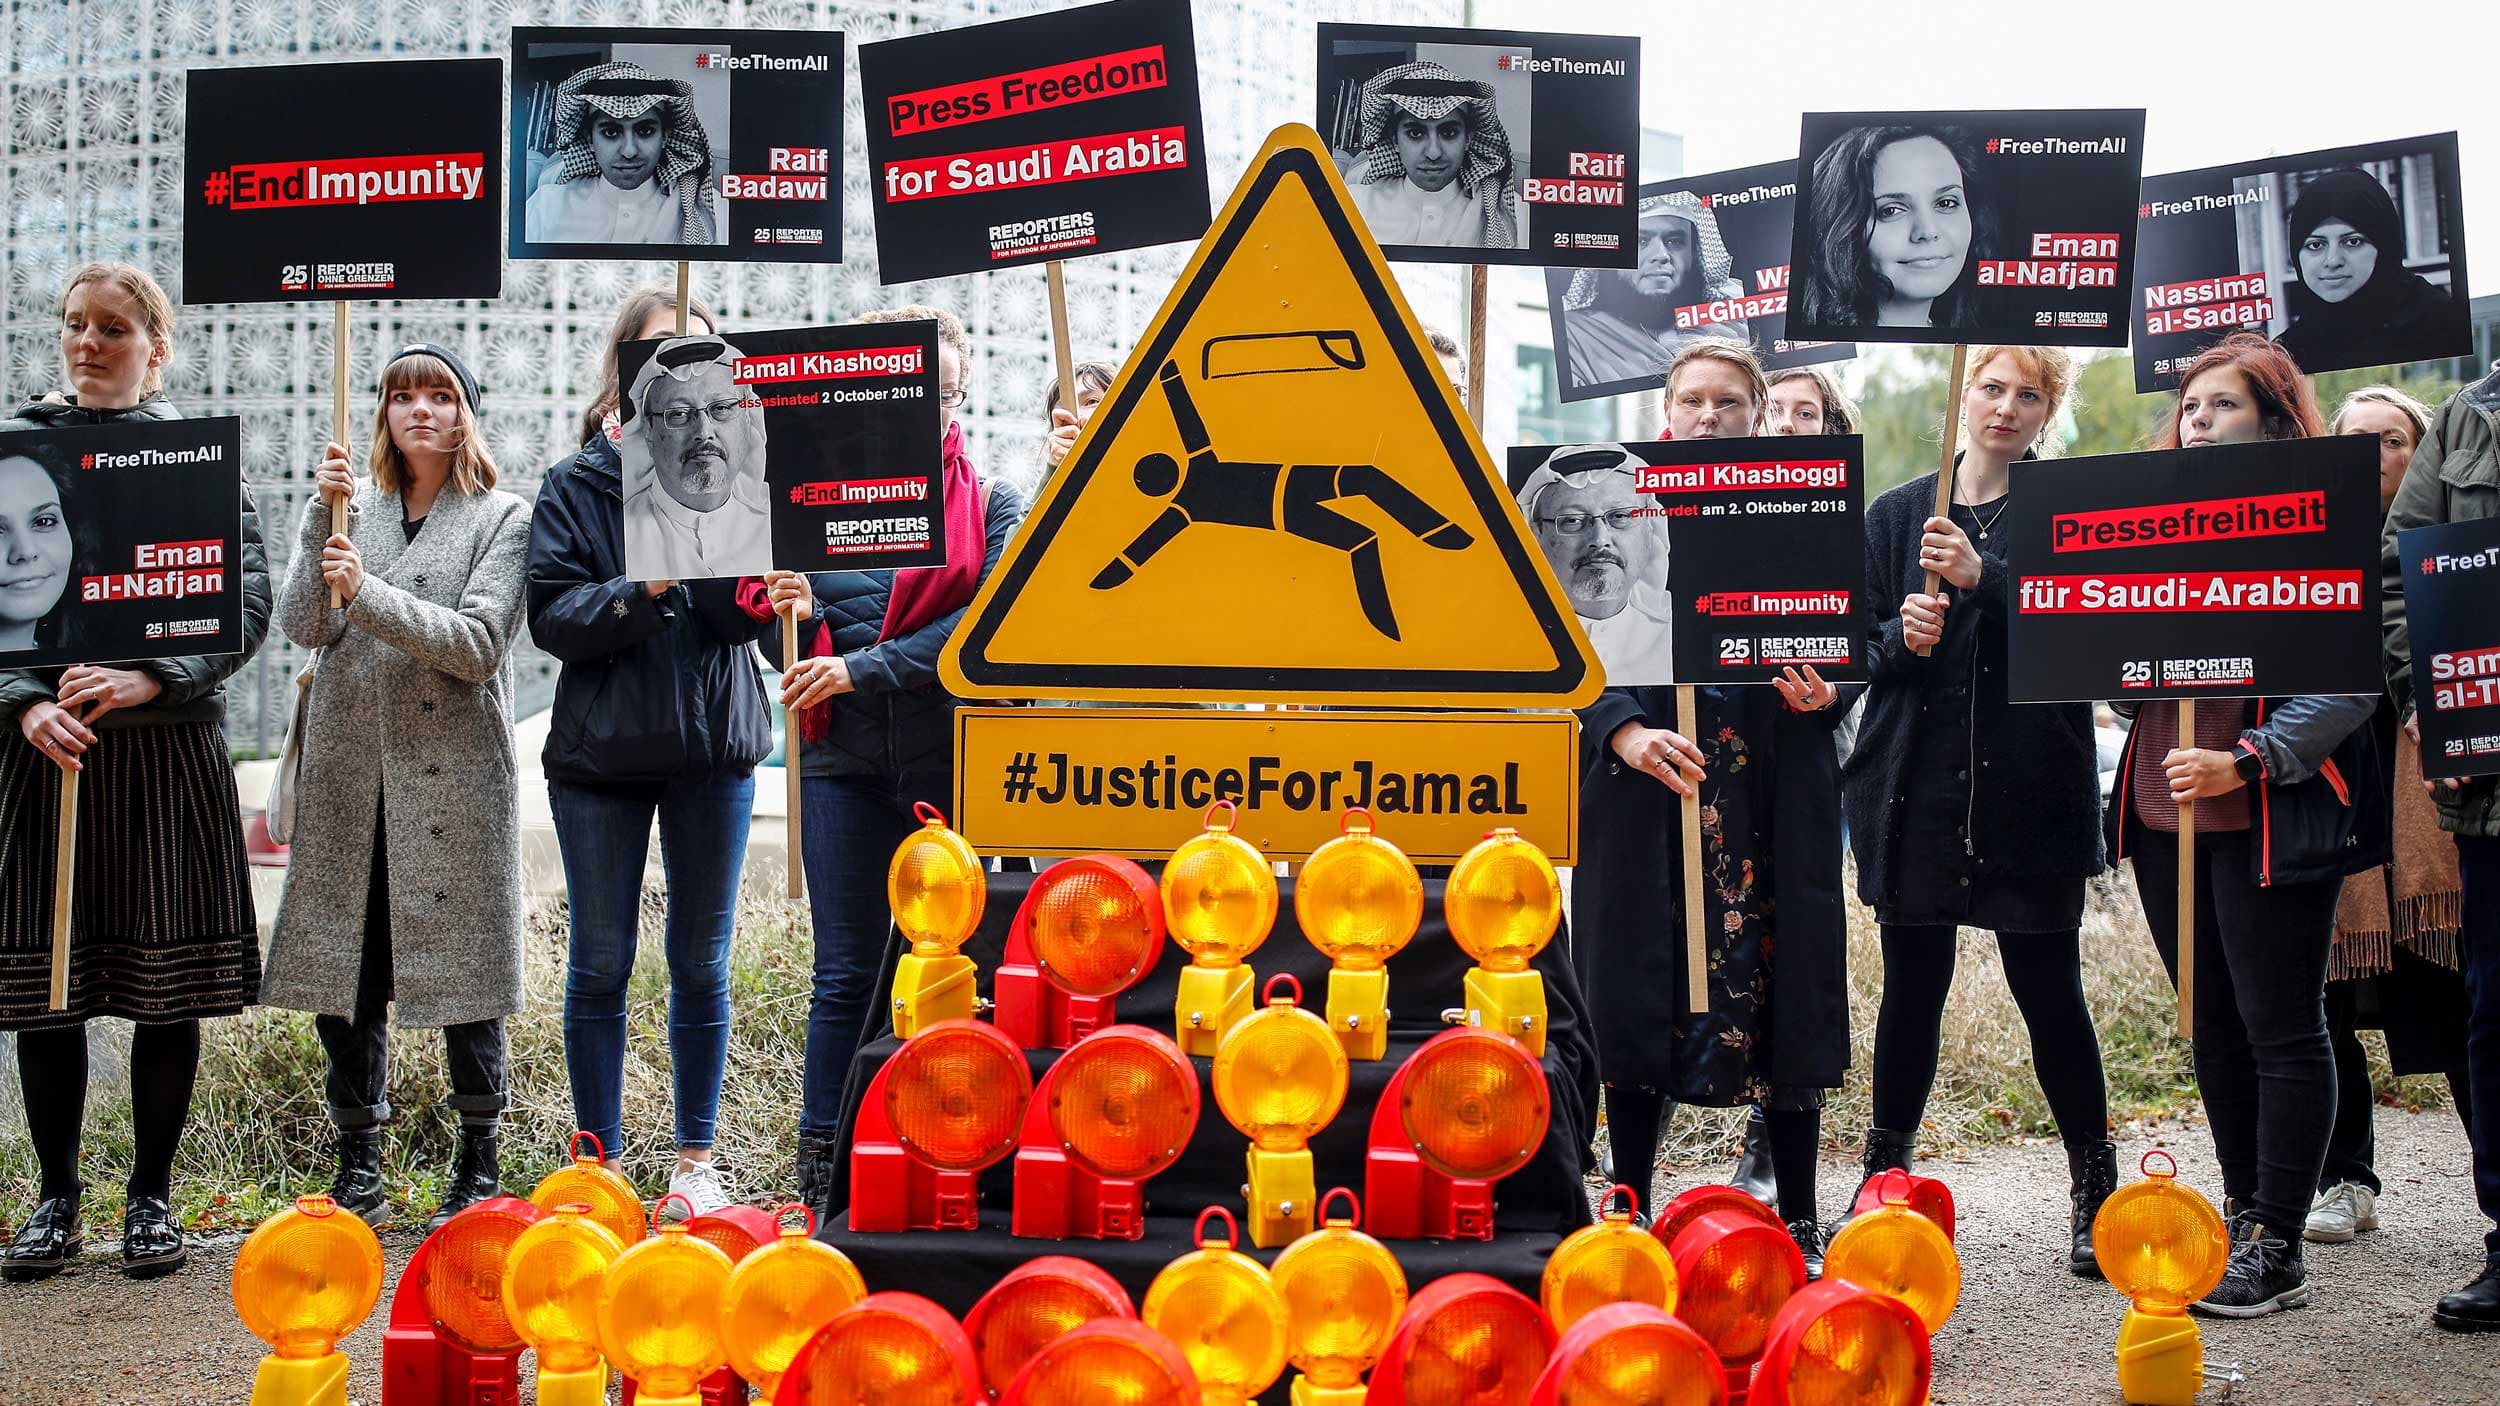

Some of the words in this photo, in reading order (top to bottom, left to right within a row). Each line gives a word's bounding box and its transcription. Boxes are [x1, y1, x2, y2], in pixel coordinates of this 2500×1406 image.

[696, 53, 828, 71] #FreeThemAll
[1498, 55, 1625, 76] #FreeThemAll
[891, 91, 991, 130] Press
[1001, 57, 1164, 111] Freedom
[1985, 137, 2126, 154] #FreeThemAll
[771, 148, 828, 171] Raif
[886, 167, 937, 198] for
[948, 148, 1051, 190] Saudi
[1063, 134, 1185, 178] Arabia
[1570, 153, 1624, 176] Raif
[204, 160, 483, 205] #EndImpunity
[722, 175, 827, 199] Badawi
[1523, 179, 1623, 204] Badawi
[2139, 186, 2269, 218] #FreeThemAll
[754, 228, 770, 240] 25
[776, 228, 823, 236] REPORTER
[989, 211, 1095, 241] REPORTERS
[991, 235, 1040, 251] WITHOUT
[1043, 227, 1096, 243] BORDERS
[1554, 233, 1570, 244] 25
[1575, 233, 1619, 241] REPORTER
[2032, 233, 2117, 257] Eman
[281, 265, 308, 284] 25
[317, 263, 394, 275] REPORTER
[318, 274, 345, 283] OHNE
[347, 273, 394, 283] GRENZEN
[1978, 261, 2114, 289] al-Nafjan
[2145, 277, 2266, 308] Nassima
[2035, 311, 2053, 323] 25
[2058, 312, 2108, 320] REPORTER
[2147, 299, 2273, 334] al-Sadah
[733, 357, 795, 380] Jamal
[803, 349, 922, 375] Khashoggi
[2154, 360, 2169, 371] 25
[739, 392, 819, 408] assasinated
[822, 392, 830, 404] 2
[833, 389, 888, 403] October
[891, 386, 924, 399] 2018
[80, 445, 222, 469] #FreeThemAll
[1635, 467, 1705, 489] Jamal
[1713, 463, 1845, 487] Khashoggi
[790, 480, 928, 504] #EndImpunity
[1631, 504, 1699, 518] ermordet
[1702, 504, 1725, 516] am
[1728, 503, 1742, 515] 2.
[1745, 500, 1807, 514] Oktober
[1811, 500, 1846, 512] 2018
[825, 516, 930, 536] REPORTERS
[2055, 498, 2324, 547] Pressefreiheit
[827, 535, 875, 546] WITHOUT
[878, 532, 930, 543] BORDERS
[137, 544, 222, 568] Eman
[83, 571, 222, 600] al-Nafjan
[2019, 581, 2071, 609] für
[2080, 576, 2359, 609] Saudi-Arabien
[1695, 594, 1849, 616] #EndImpunity
[145, 623, 163, 635] 25
[169, 618, 219, 628] REPORTER
[1720, 638, 1750, 659] 25
[1761, 637, 1849, 649] REPORTER
[1761, 648, 1793, 658] OHNE
[1796, 648, 1849, 658] GRENZEN
[2122, 661, 2152, 681] 25
[2163, 657, 2253, 672] REPORTER
[2163, 671, 2195, 680] OHNE
[2198, 669, 2253, 679] GRENZEN
[2436, 678, 2500, 709] al-T
[2445, 740, 2464, 753] 25
